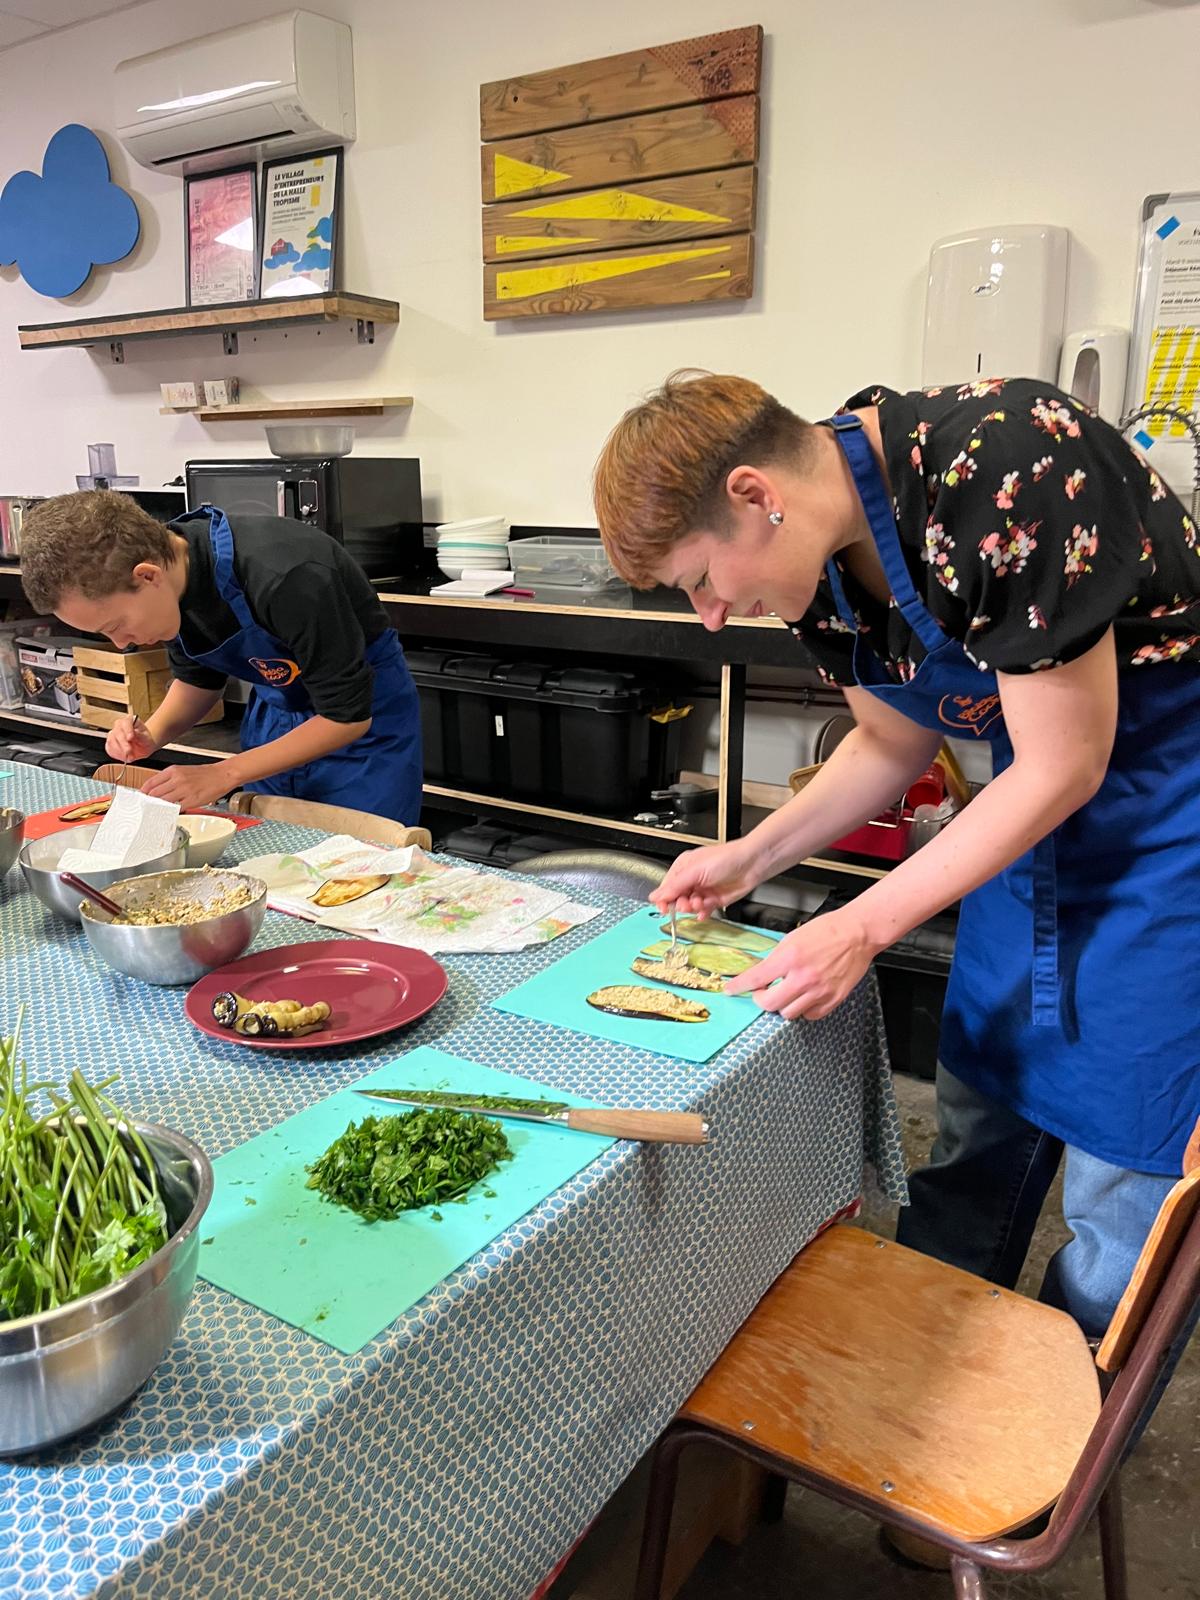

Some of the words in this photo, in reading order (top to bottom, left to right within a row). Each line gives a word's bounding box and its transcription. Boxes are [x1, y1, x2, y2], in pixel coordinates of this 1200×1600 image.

[281, 170, 304, 179] VILLAGE
[274, 175, 324, 190] D'ENTREPRENEURS
[281, 189, 288, 197] LA
[289, 186, 306, 196] HALLE
[273, 196, 300, 207] TROPISME
